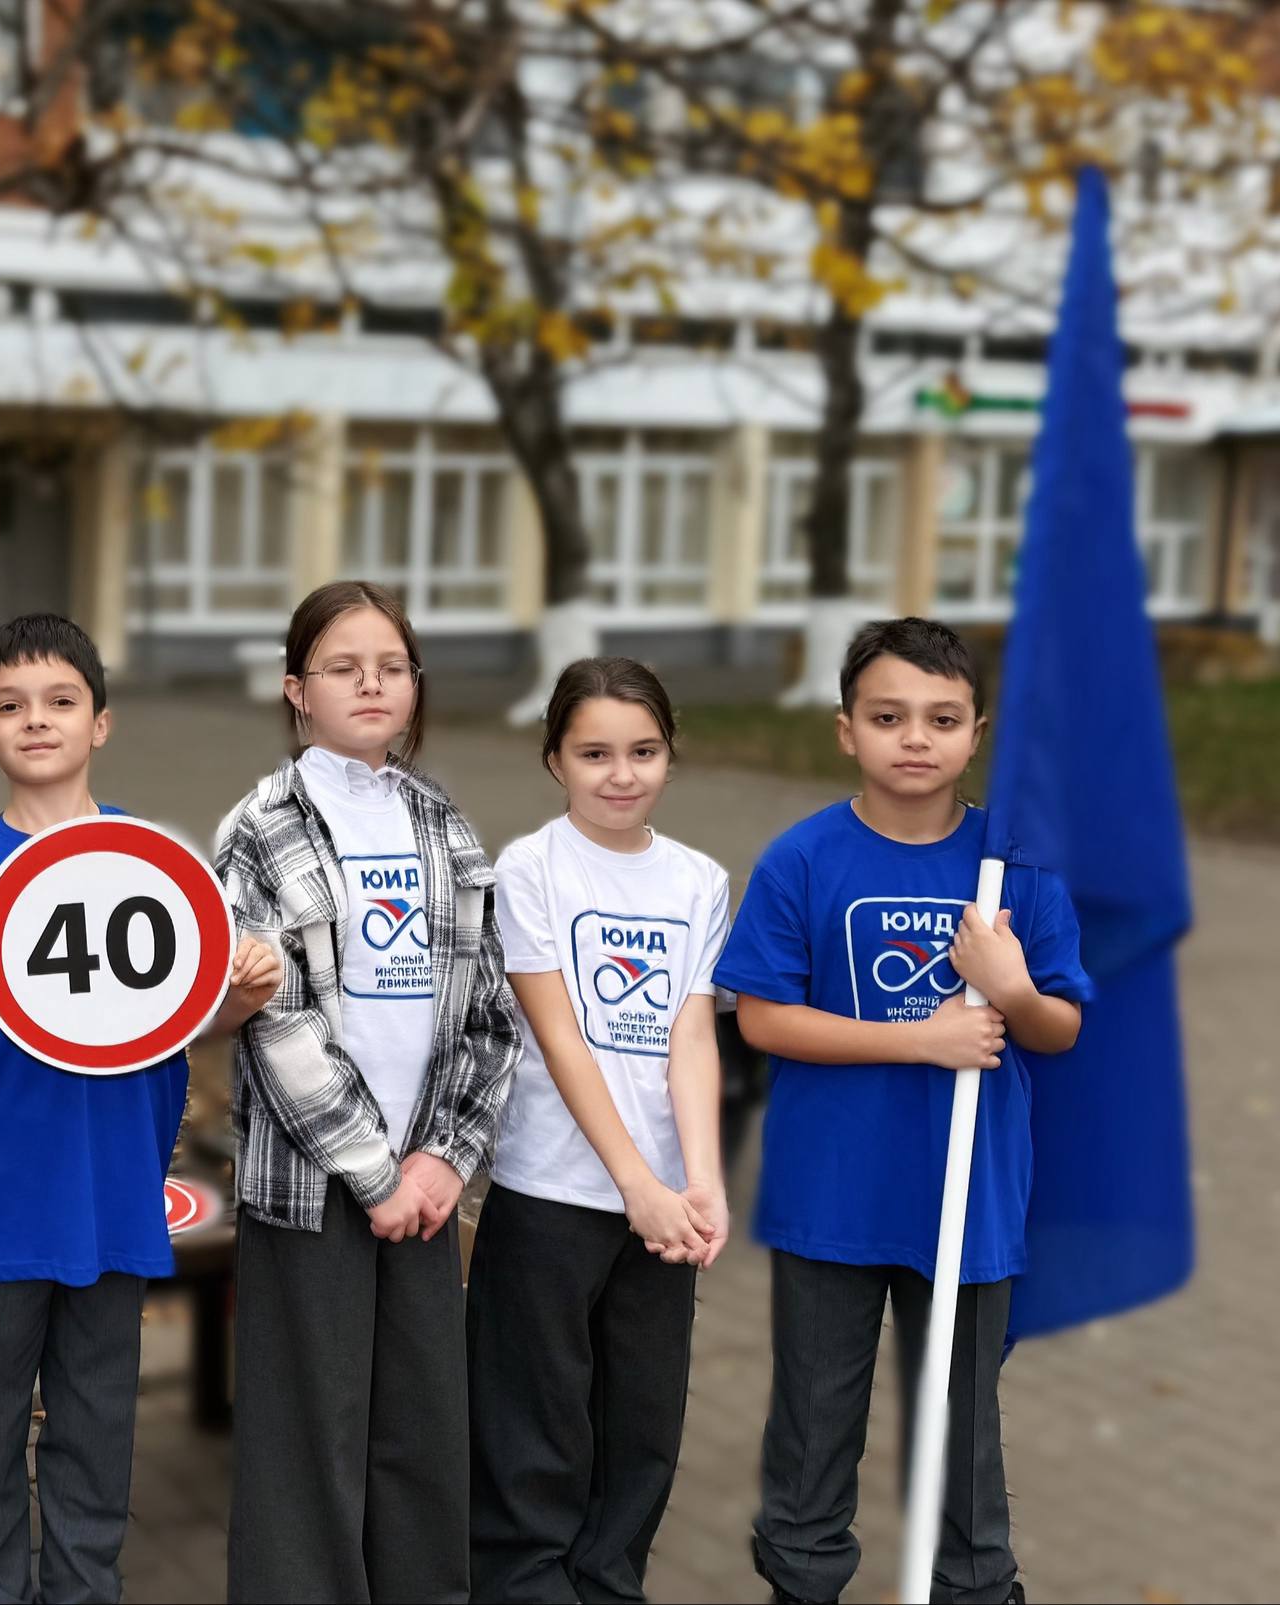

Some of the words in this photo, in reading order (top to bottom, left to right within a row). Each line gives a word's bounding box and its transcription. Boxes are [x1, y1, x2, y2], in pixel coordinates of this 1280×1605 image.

[360, 868, 420, 891] ЮИД
[881, 911, 955, 937] ЮИД
[26, 895, 176, 994] 40
[601, 926, 667, 954] ЮИД
[390, 952, 425, 965] ЮНЫЙ
[619, 1011, 657, 1024] ЮНЫЙ
